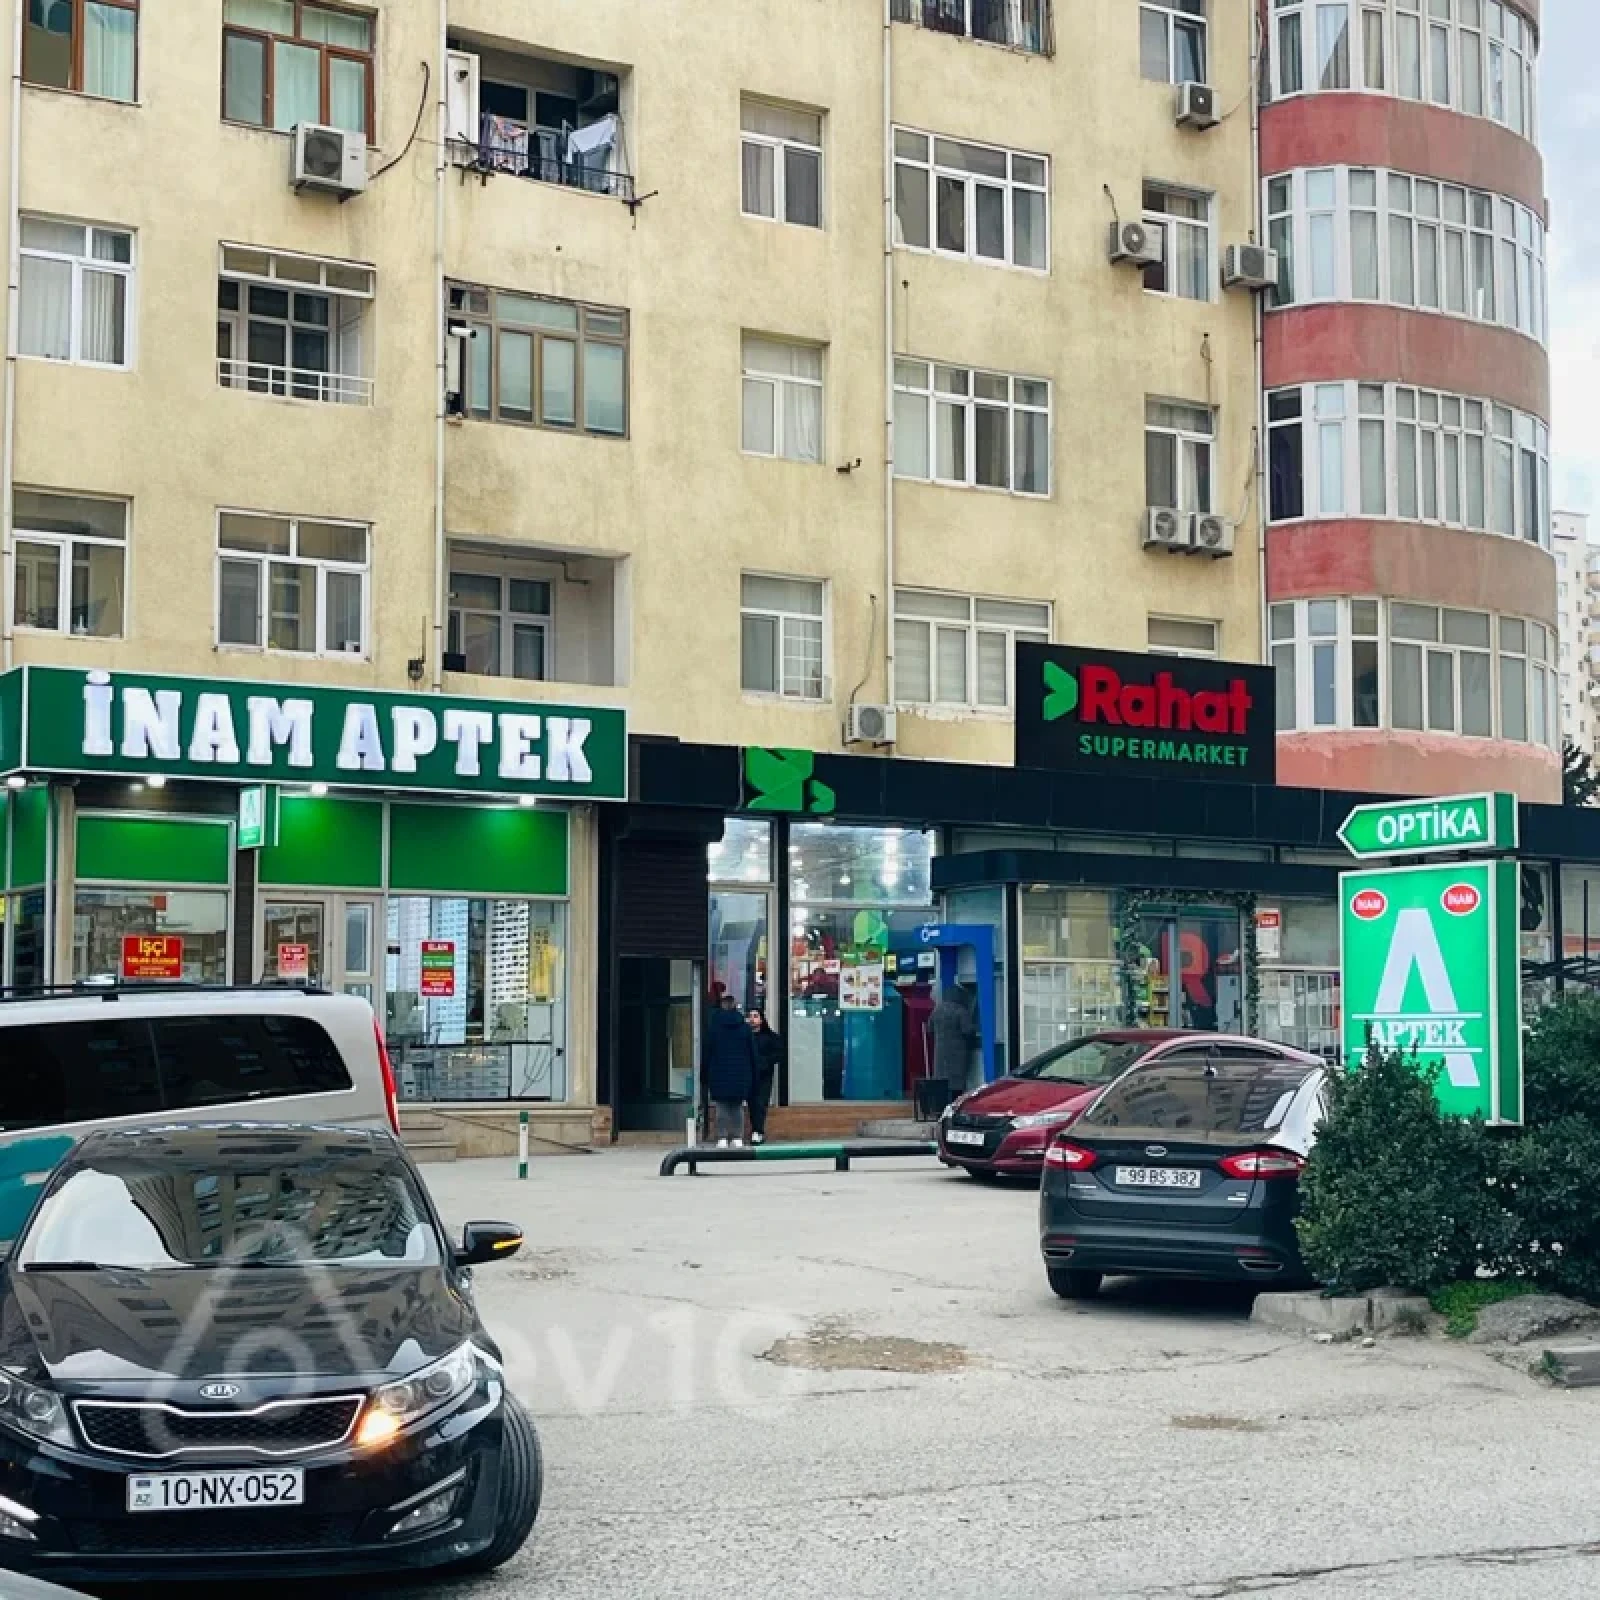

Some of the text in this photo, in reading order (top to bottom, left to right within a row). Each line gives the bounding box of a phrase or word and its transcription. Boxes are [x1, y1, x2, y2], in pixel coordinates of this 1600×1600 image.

[1079, 663, 1253, 734] Rahat
[82, 671, 593, 783] İNAM APTEK
[1079, 734, 1249, 767] SUPERMARKET
[1377, 804, 1481, 845] OPTİKA
[1370, 1020, 1467, 1047] APTEK
[160, 1473, 297, 1506] 10-NX-052
